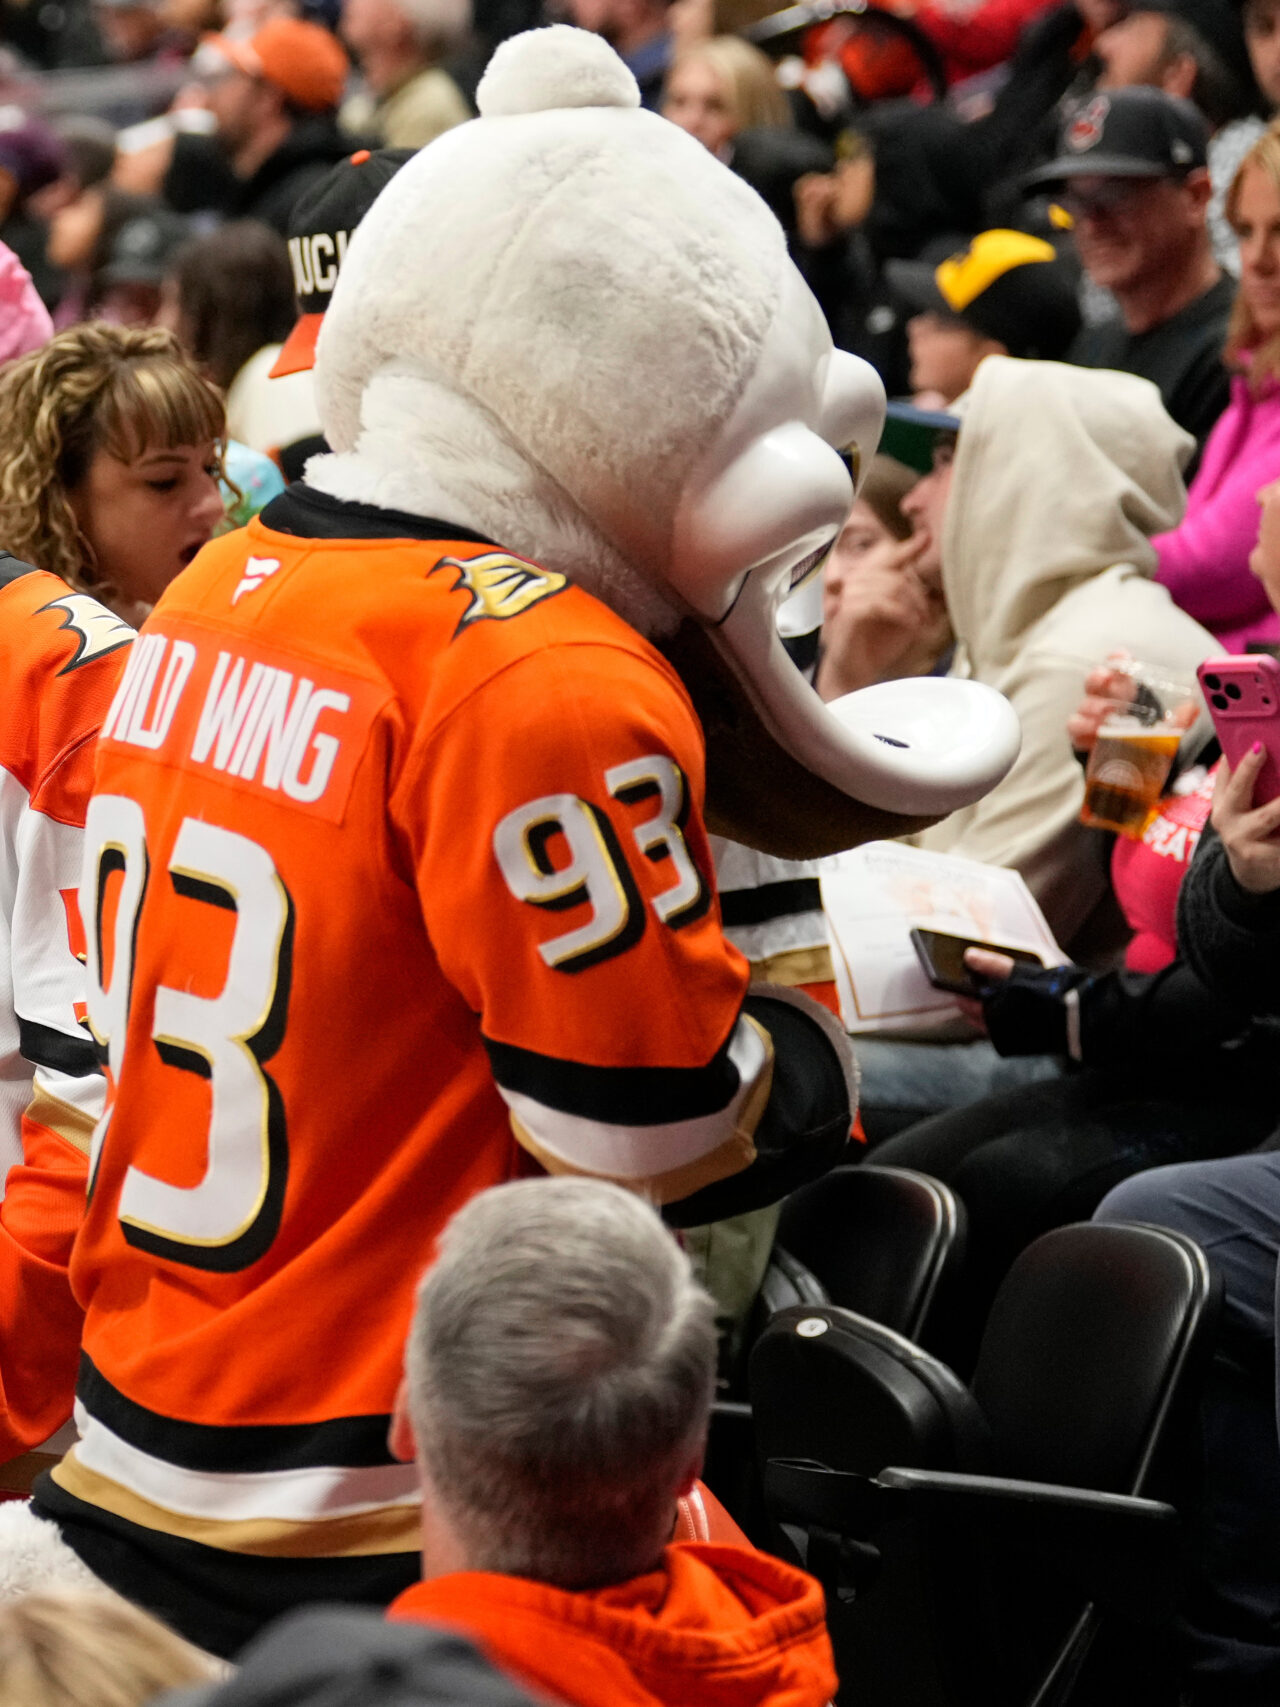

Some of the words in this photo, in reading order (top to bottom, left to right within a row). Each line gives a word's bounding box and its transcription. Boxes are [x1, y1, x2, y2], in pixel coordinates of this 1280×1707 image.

[288, 229, 356, 296] UC
[190, 650, 351, 803] WING
[493, 754, 713, 975] 93
[77, 794, 297, 1274] 93
